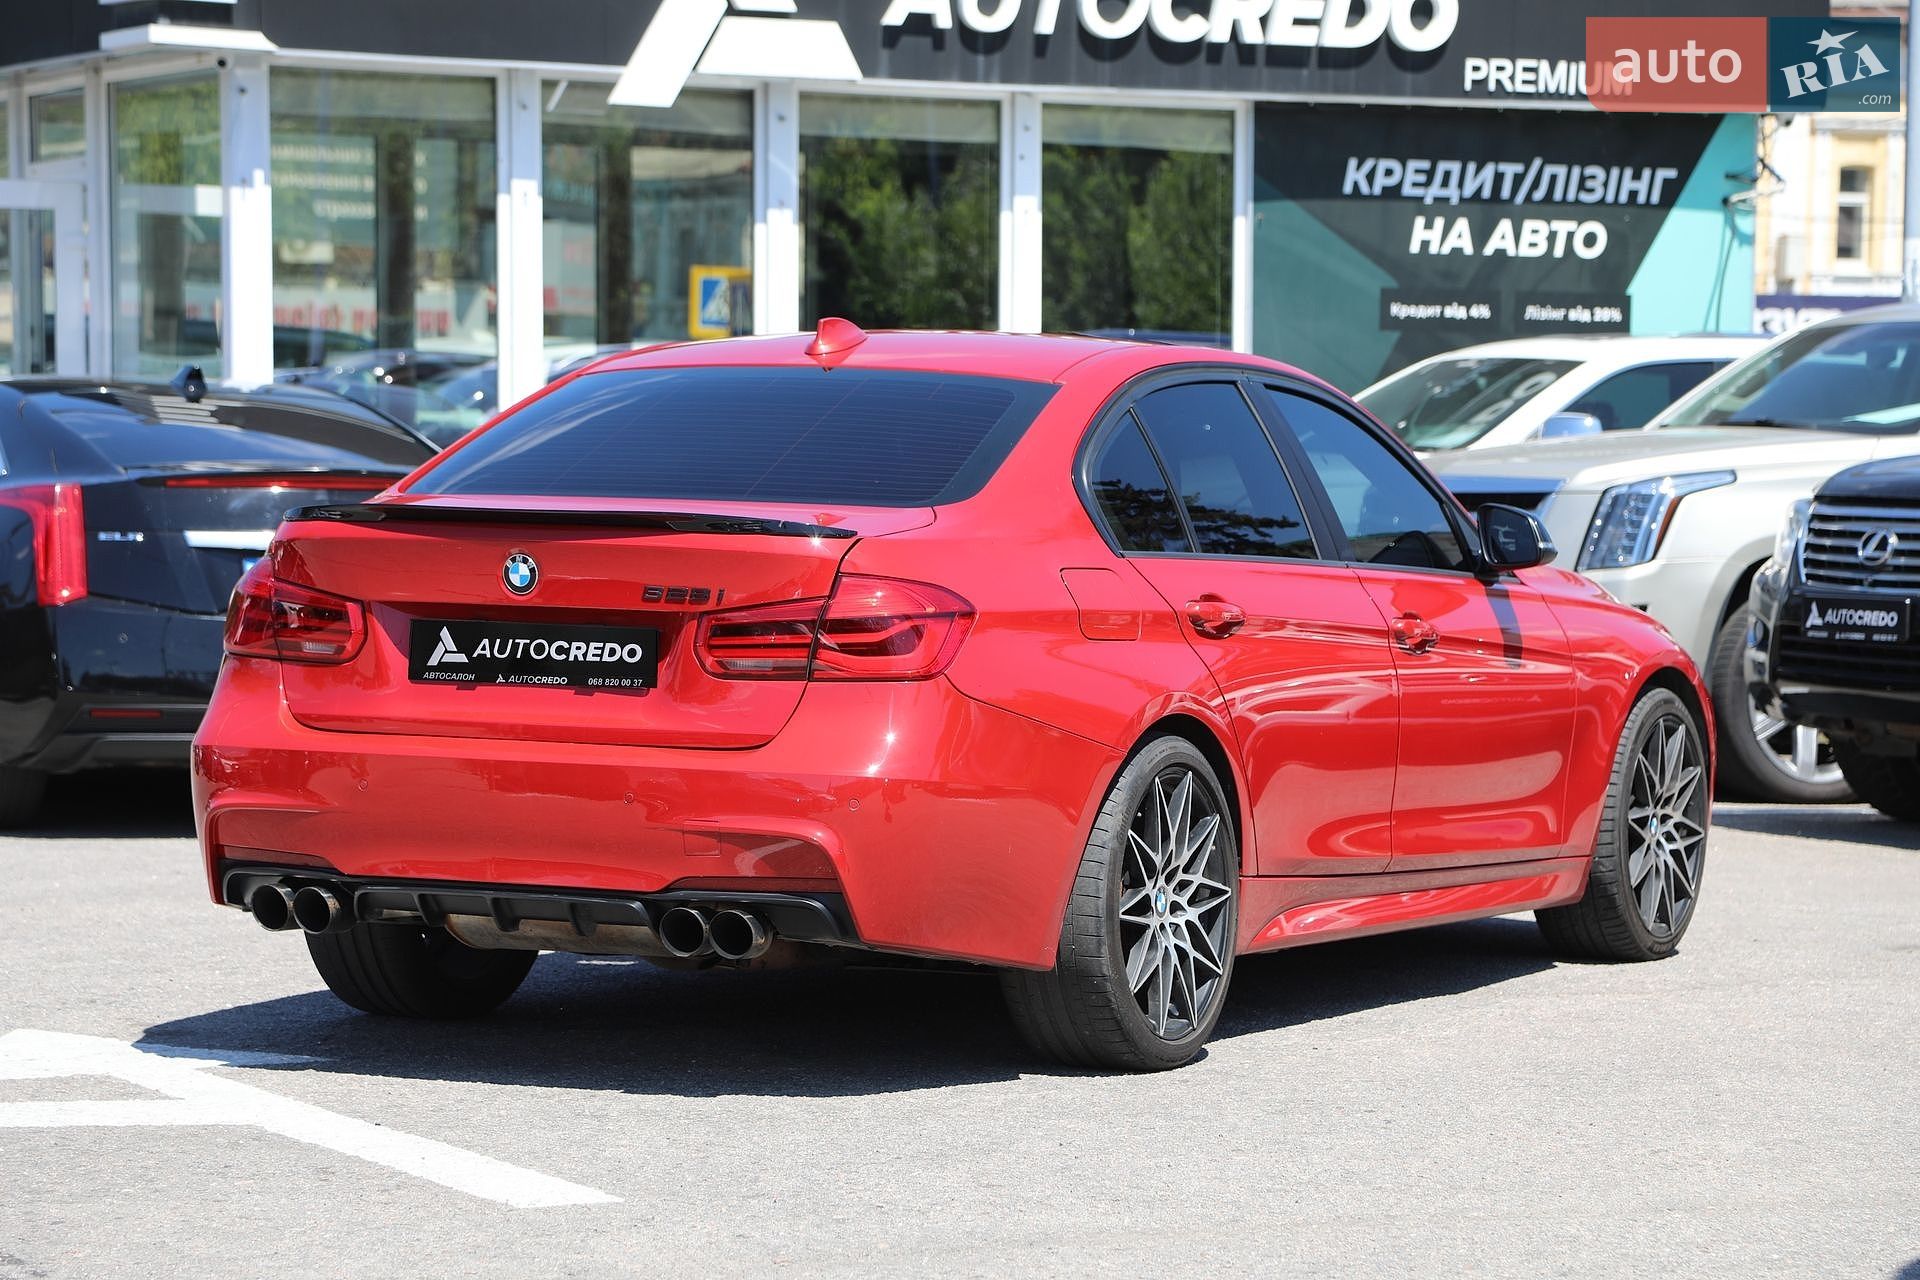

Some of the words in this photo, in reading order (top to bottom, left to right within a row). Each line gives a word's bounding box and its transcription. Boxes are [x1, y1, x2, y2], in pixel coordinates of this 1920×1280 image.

[1463, 57, 1634, 96] PREMIUM
[1342, 157, 1679, 205] КРЕДИТ/ЛІЗІНГ
[1409, 215, 1475, 256] НА
[1482, 217, 1609, 260] АВТО
[1390, 301, 1443, 320] Кредит
[1443, 302, 1468, 320] від
[1568, 305, 1592, 323] від
[1824, 608, 1899, 628] AUTOCREDO
[472, 638, 643, 663] AUTOCREDO
[422, 672, 476, 681] АВТОСАЛОН
[508, 675, 568, 685] AUTOCREDO
[588, 678, 603, 686] 068
[605, 678, 619, 686] 820
[633, 679, 643, 687] 37
